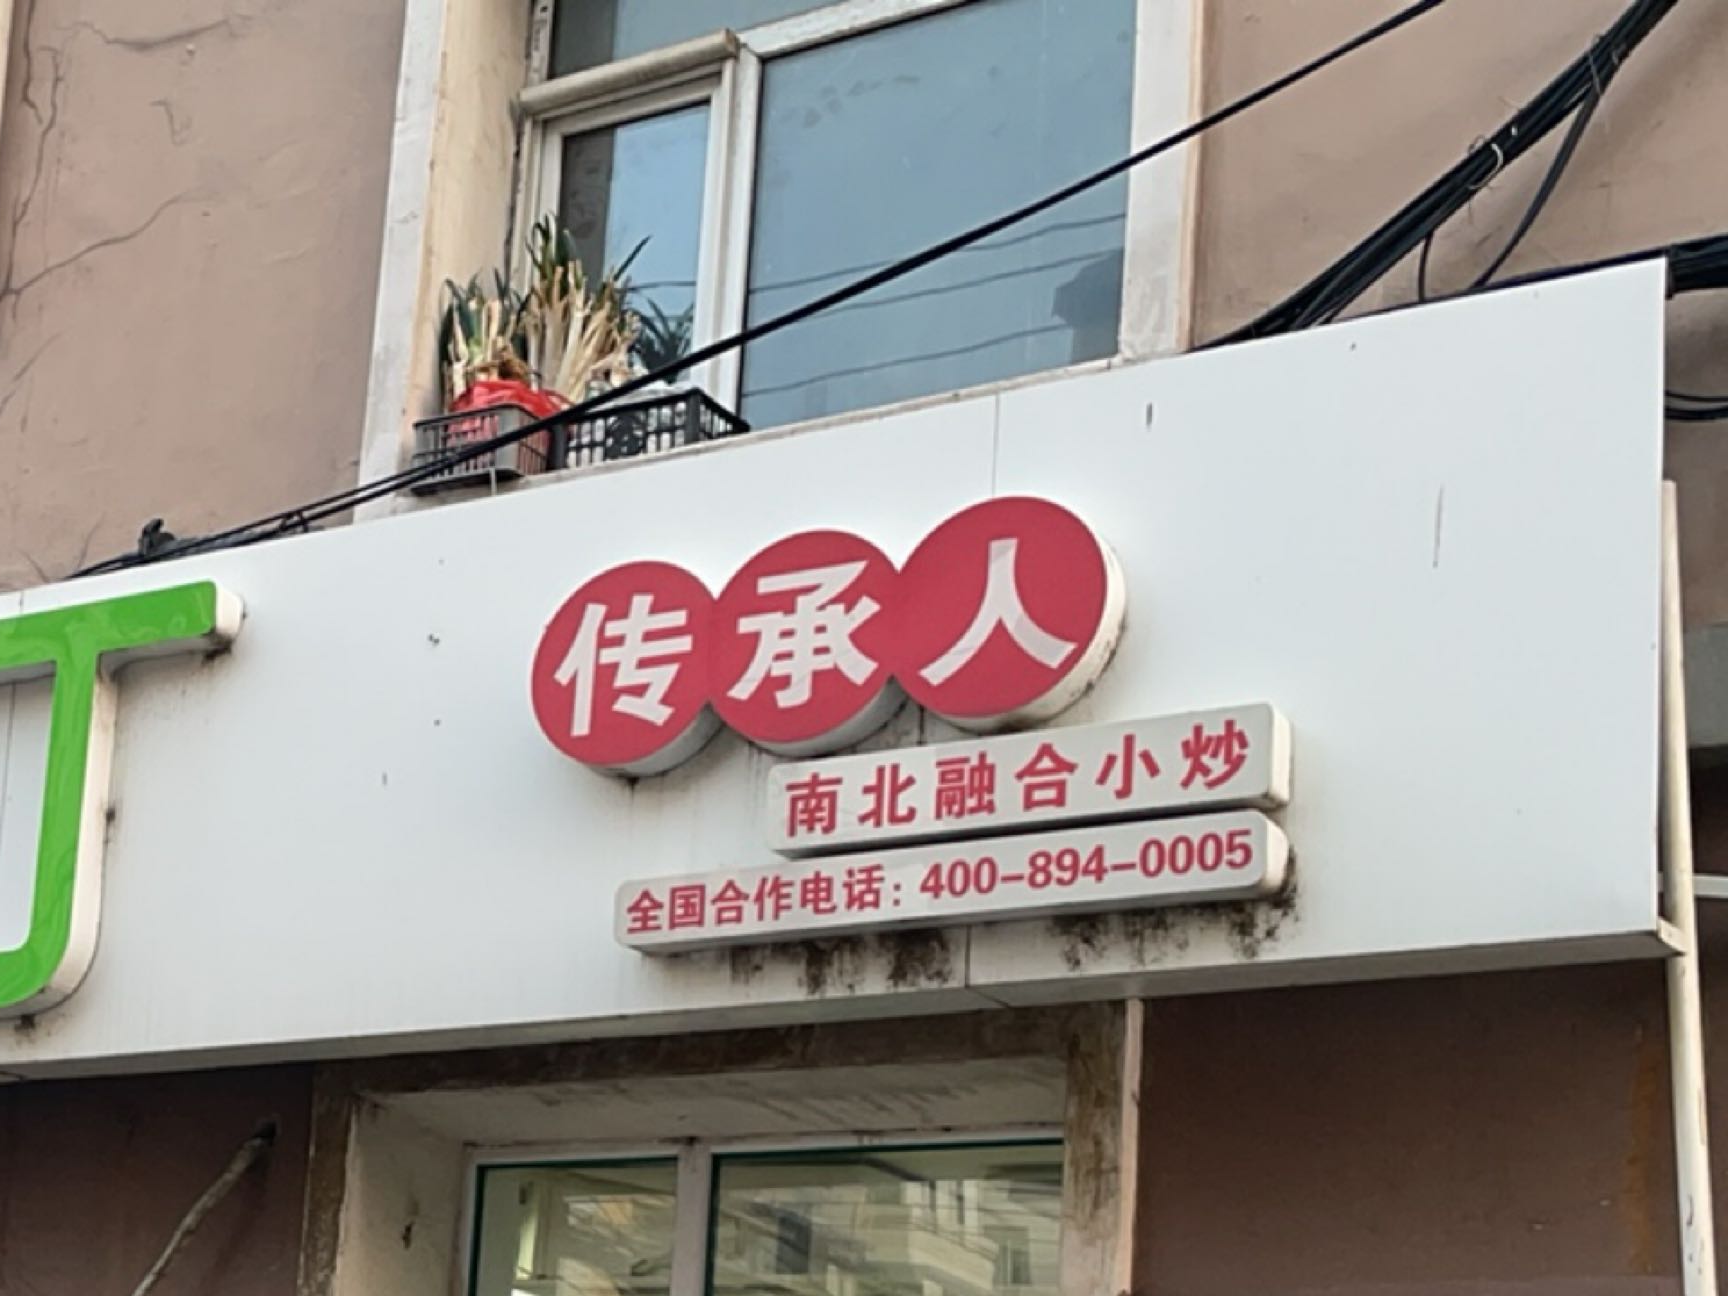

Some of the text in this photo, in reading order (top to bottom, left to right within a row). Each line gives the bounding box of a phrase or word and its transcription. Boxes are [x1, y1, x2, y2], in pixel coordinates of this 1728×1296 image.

[554, 537, 1079, 738] 传承人
[785, 718, 1250, 838] 南北融合小炒
